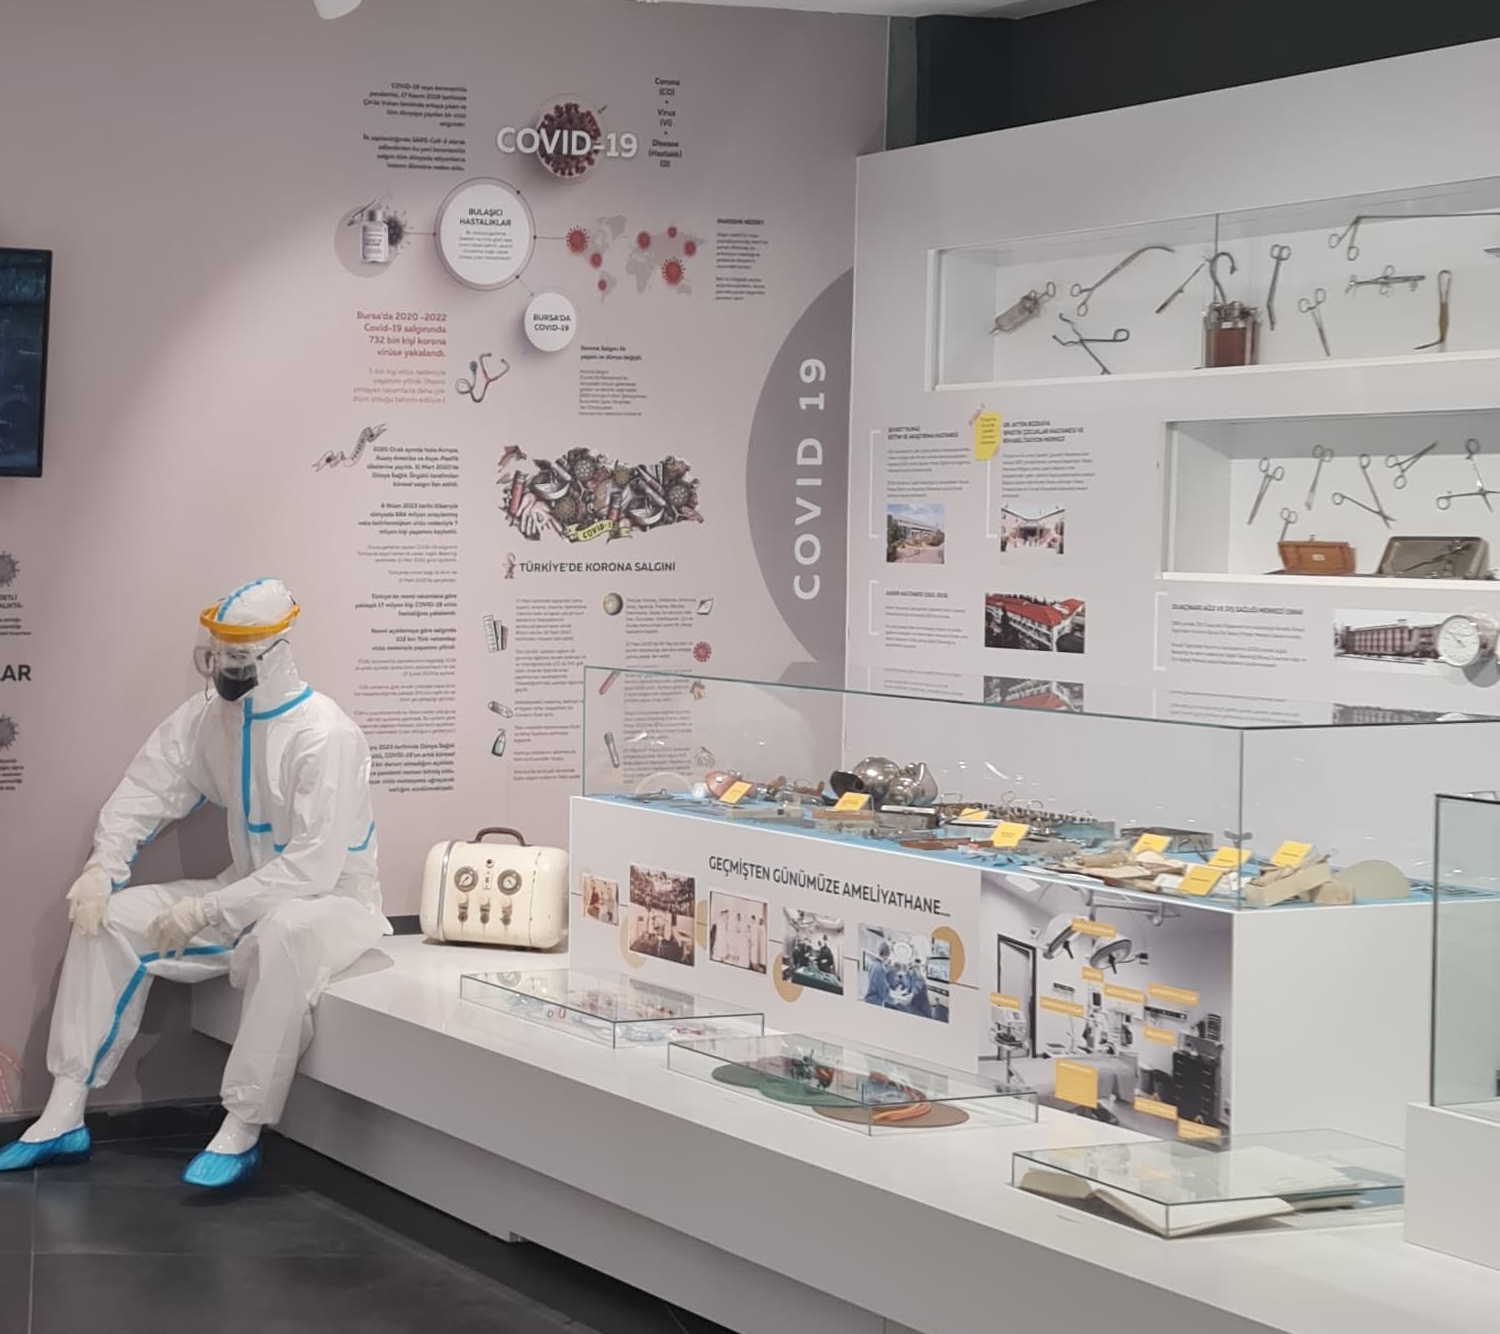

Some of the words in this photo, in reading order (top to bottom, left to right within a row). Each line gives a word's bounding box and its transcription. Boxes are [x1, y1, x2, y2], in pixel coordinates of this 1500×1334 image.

[495, 126, 639, 160] COVID-19
[459, 217, 512, 227] HASTALIKLAR
[356, 310, 394, 321] Bursa'da
[394, 311, 419, 321] 2020
[363, 322, 402, 333] Covid-19
[533, 323, 570, 333] COVID-19
[369, 335, 386, 345] 732
[386, 335, 401, 344] bin
[401, 335, 416, 347] kişi
[416, 335, 447, 346] korona
[377, 347, 402, 356] virüse
[798, 357, 827, 411] 19
[792, 437, 824, 601] COVID
[518, 559, 585, 574] TÜRKİYE'DE
[584, 560, 633, 574] KORONA
[633, 560, 677, 574] SALGINI
[708, 855, 771, 882] GEÇMİŞTEN
[772, 867, 841, 896] GÜNÜMÜZE
